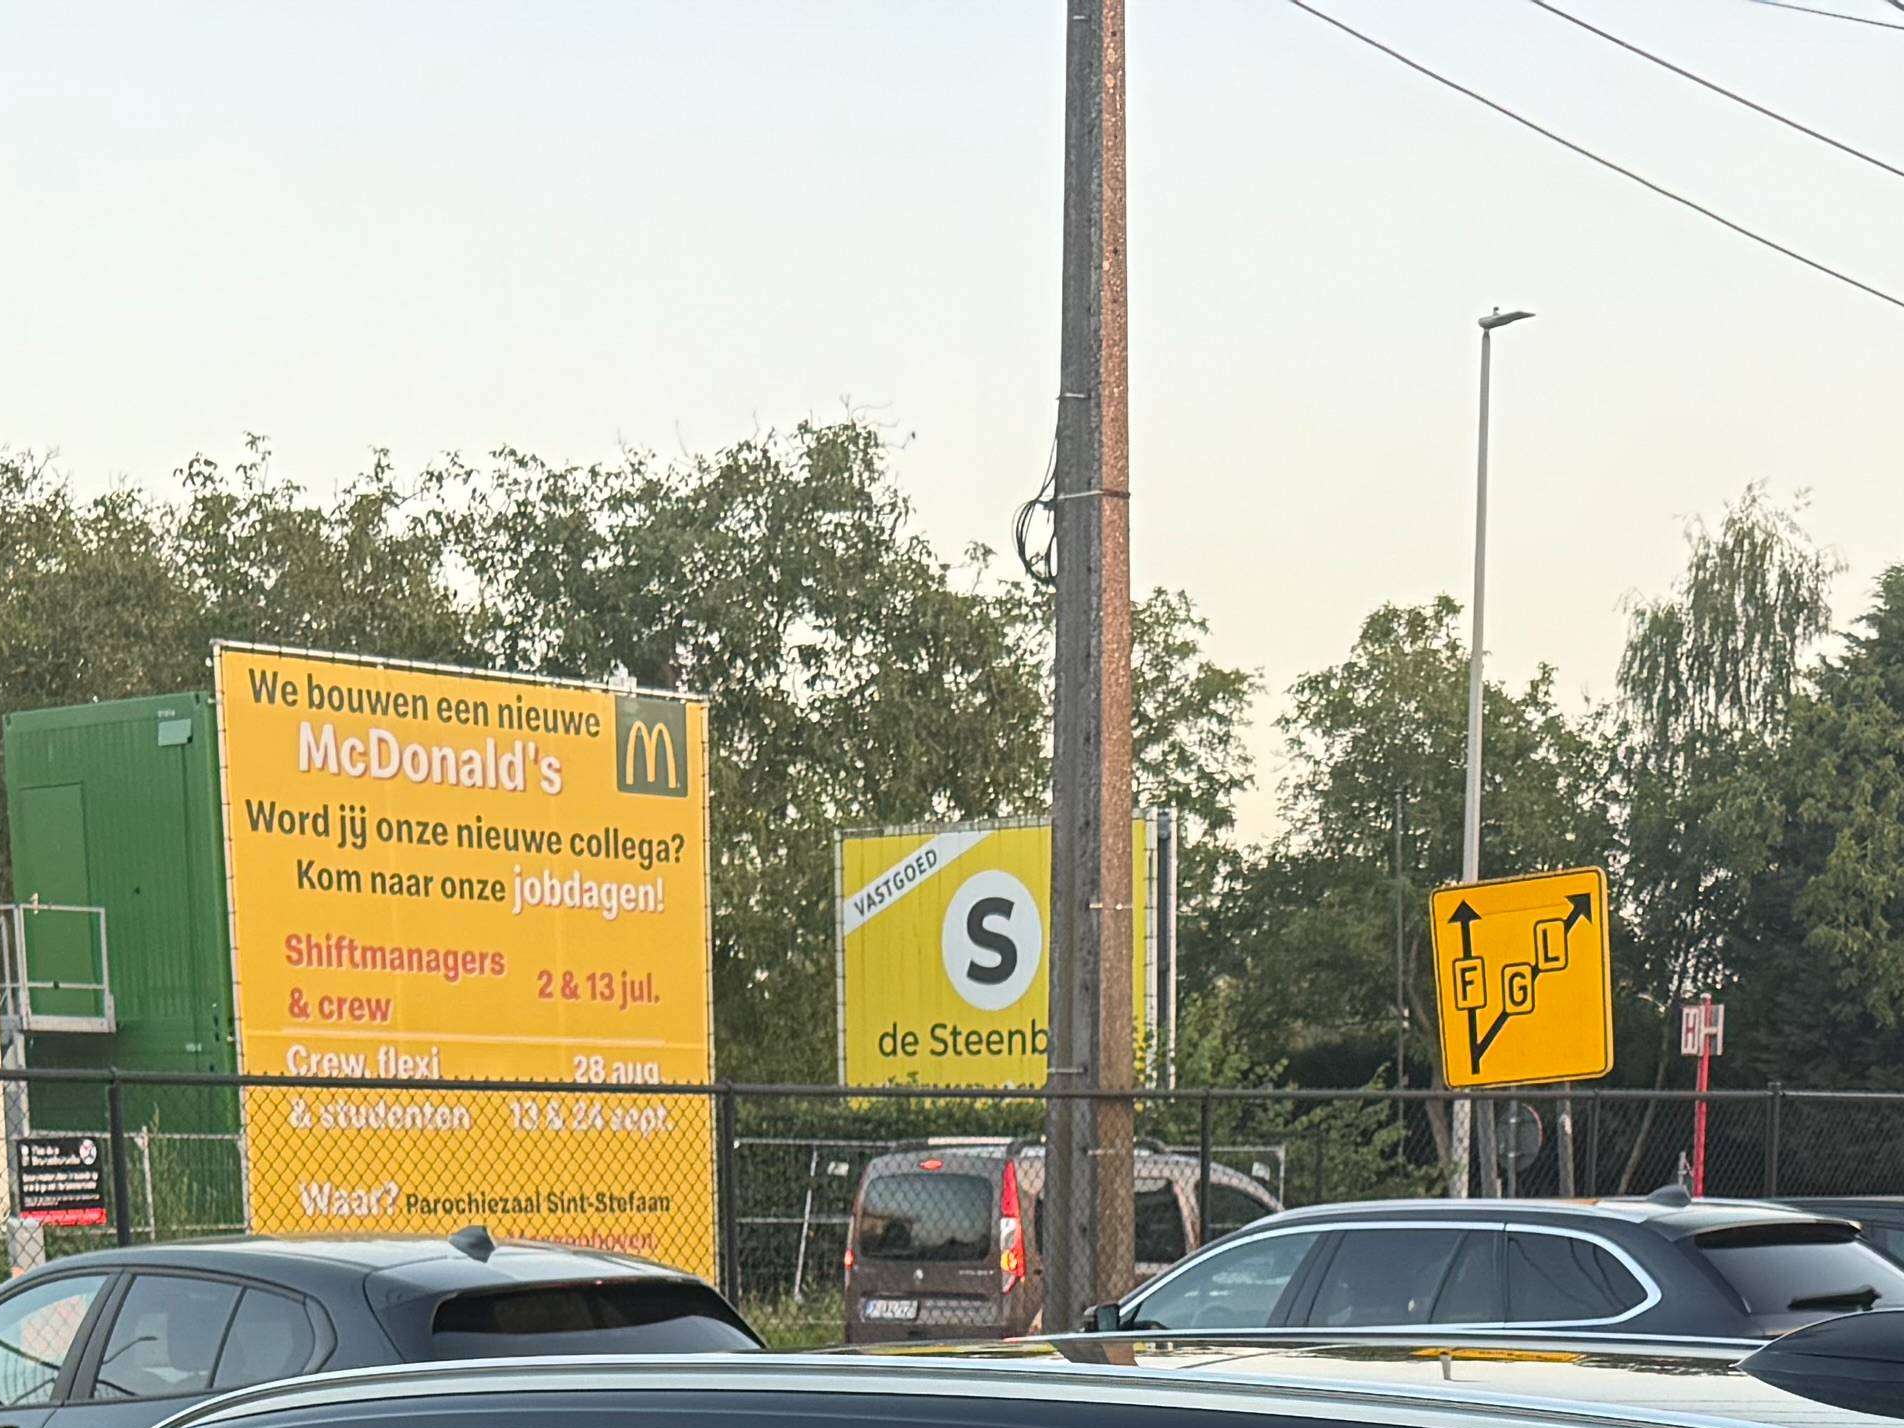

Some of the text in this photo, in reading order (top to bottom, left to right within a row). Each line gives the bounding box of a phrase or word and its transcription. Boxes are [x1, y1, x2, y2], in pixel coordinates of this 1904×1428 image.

[247, 668, 601, 738] We bouwen een nieuwe
[298, 720, 563, 795] McDonald's
[245, 799, 330, 838] Word
[376, 816, 448, 848] onze
[457, 815, 563, 856] nieuwe
[569, 827, 685, 871] collega?
[296, 859, 665, 921] Kom naar onze jobdagen!
[853, 848, 939, 917] VASTGOED
[284, 933, 507, 983] Shiftmanagers
[965, 896, 1019, 986] S
[1542, 928, 1560, 964] L
[537, 970, 661, 1011] 2 & 13 jul.
[1460, 964, 1478, 1002] F
[1507, 971, 1529, 1008] G
[288, 988, 393, 1023] & crew
[878, 1018, 1049, 1057] de Steenb
[377, 1045, 441, 1080] flexi
[573, 1055, 605, 1084] 28
[288, 1099, 473, 1132] & studenten
[299, 1180, 672, 1218] Waar? Parochiezaal Sint-Stefaan
